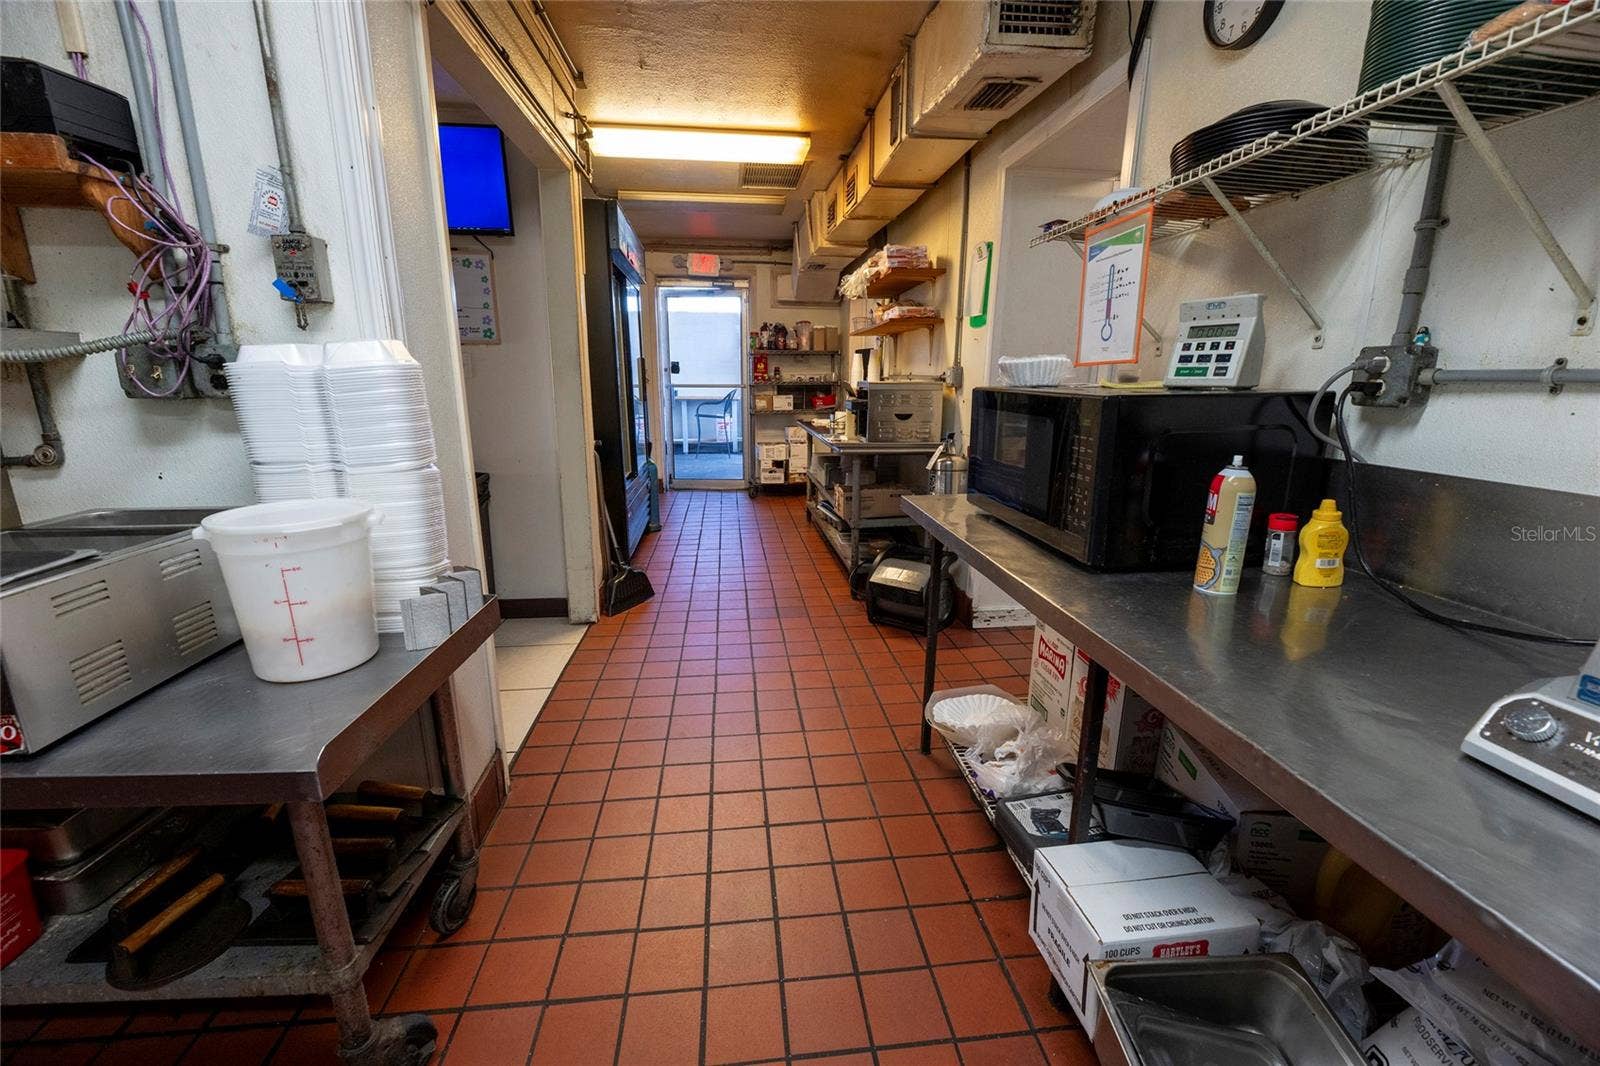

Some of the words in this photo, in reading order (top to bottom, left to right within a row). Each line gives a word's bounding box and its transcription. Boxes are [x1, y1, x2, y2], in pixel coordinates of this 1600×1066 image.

[1039, 640, 1066, 677] MARINA
[0, 725, 17, 740] O
[1133, 912, 1143, 920] NOT
[1143, 910, 1163, 919] STACK
[1163, 908, 1178, 917] OVER
[1134, 924, 1146, 932] NOT
[1147, 923, 1158, 931] CUT
[1158, 921, 1167, 929] OR
[1048, 927, 1071, 969] FRAGILE
[1105, 949, 1119, 959] 100
[1120, 946, 1141, 957] CUPS
[1160, 944, 1201, 958] HARTLEY'S
